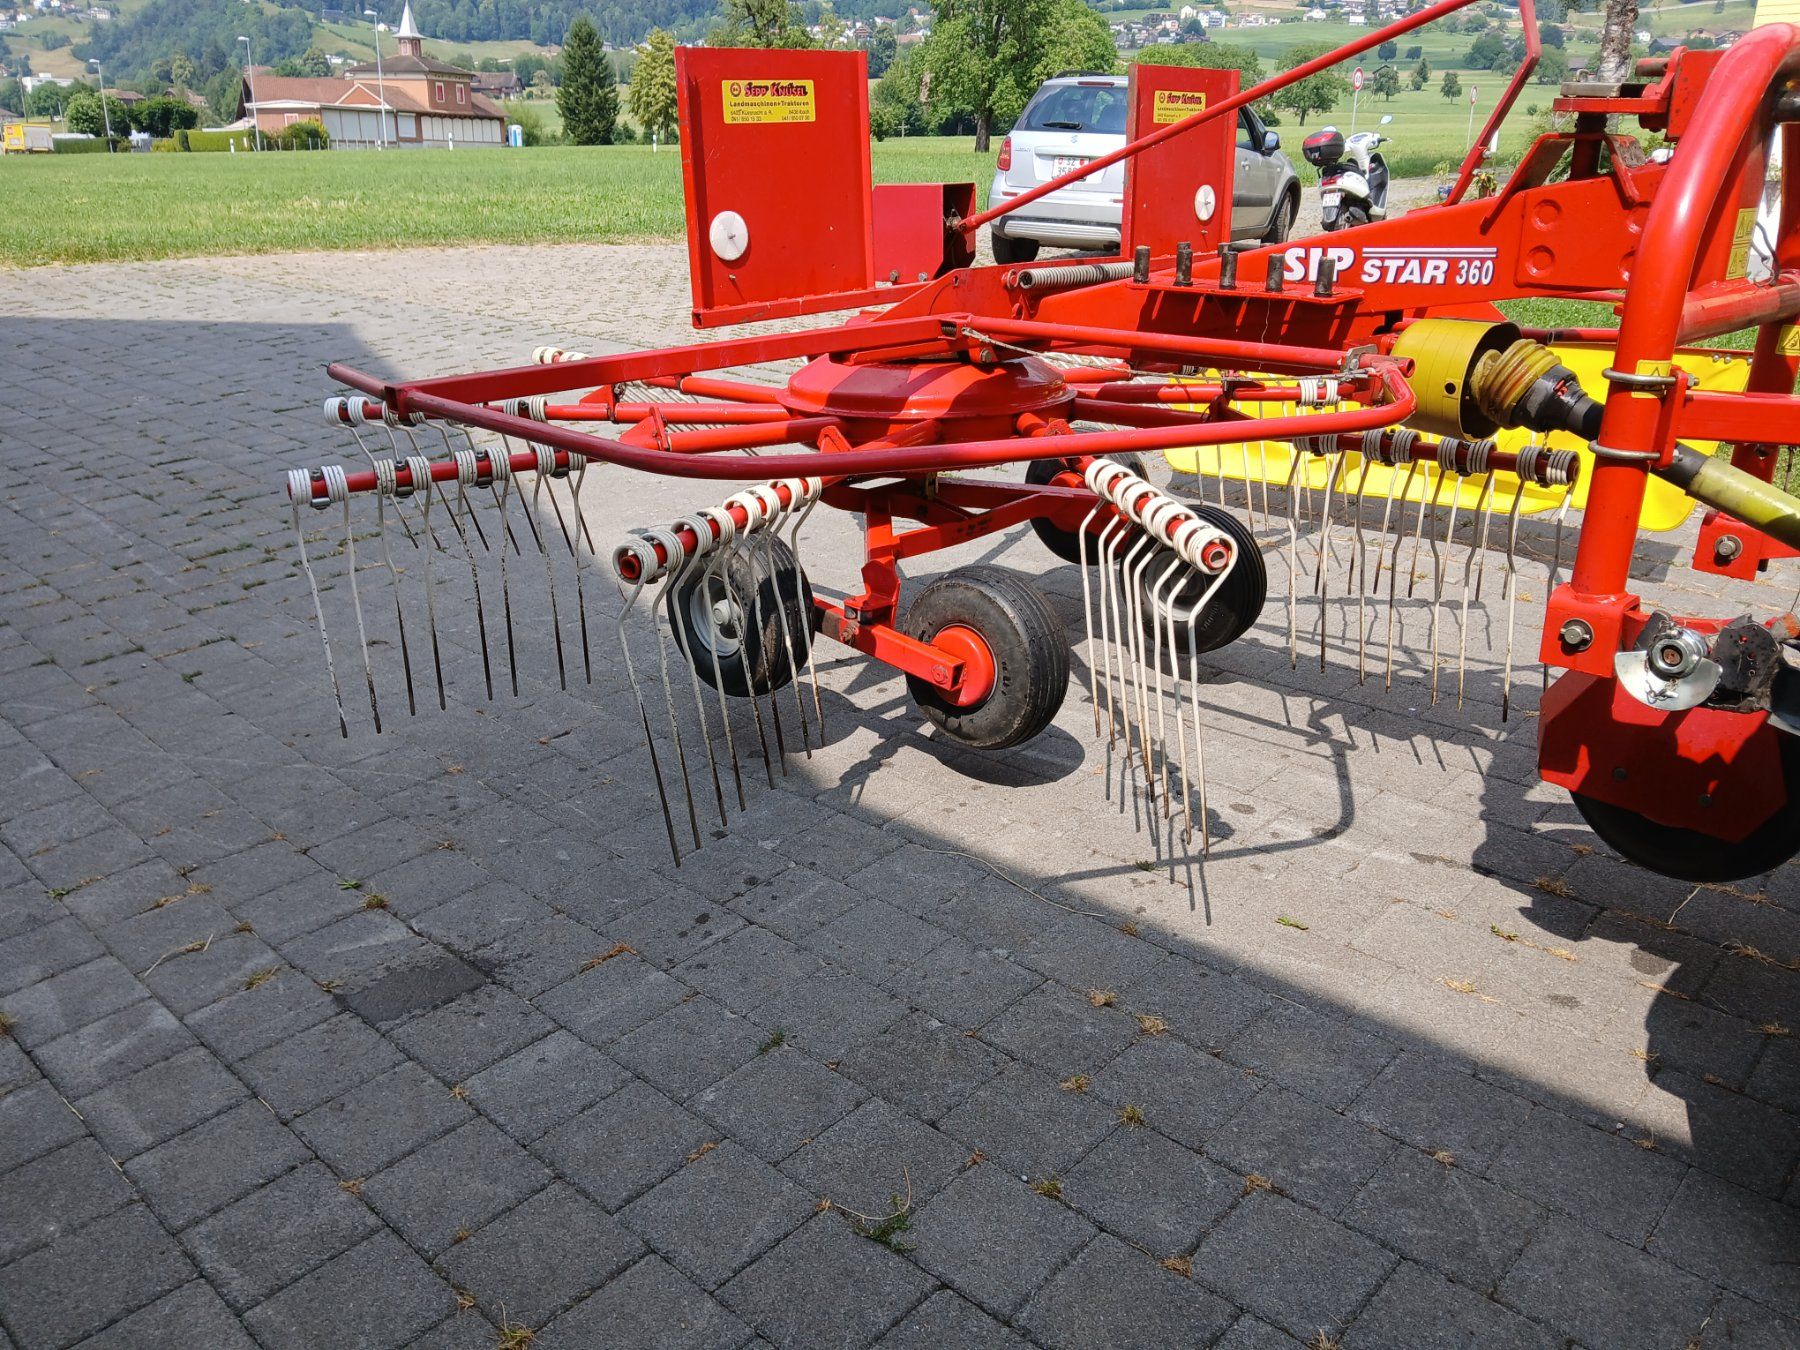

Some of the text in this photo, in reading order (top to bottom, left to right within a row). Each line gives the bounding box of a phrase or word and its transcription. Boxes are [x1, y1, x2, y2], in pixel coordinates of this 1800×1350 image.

[1284, 247, 1494, 285] SIP STAR 360
